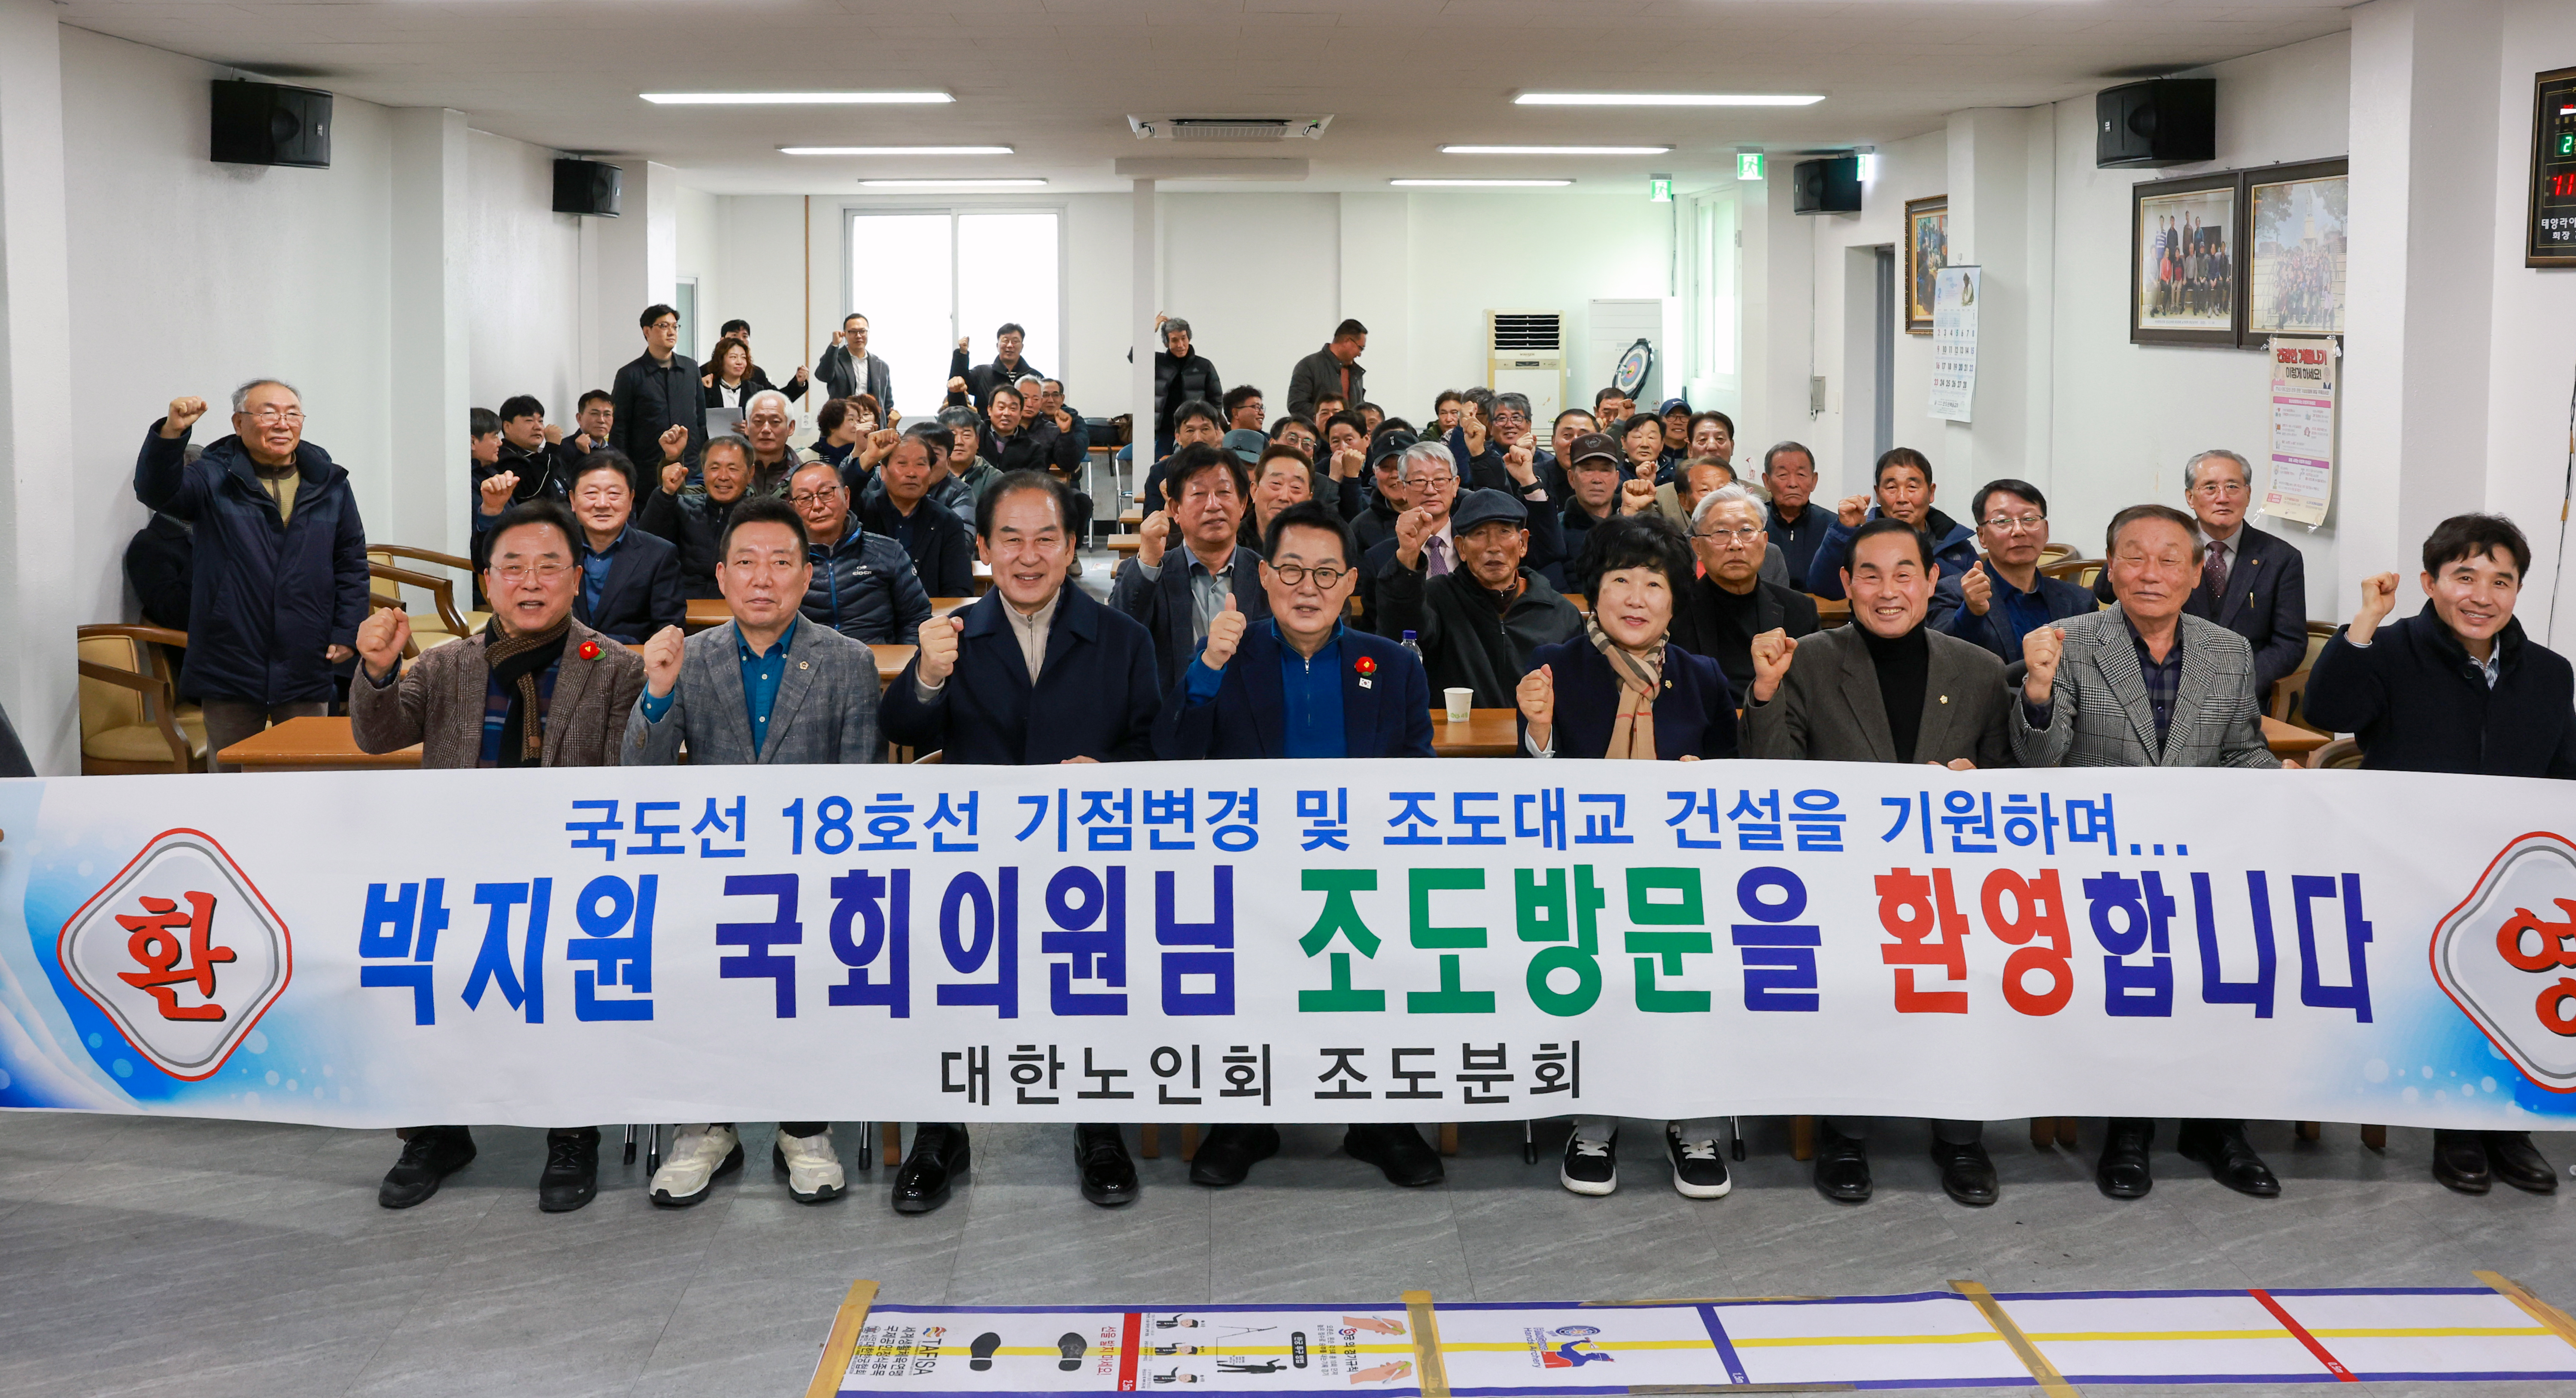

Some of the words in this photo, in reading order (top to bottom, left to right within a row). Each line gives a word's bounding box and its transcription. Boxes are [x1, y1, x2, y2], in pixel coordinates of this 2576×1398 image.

[2552, 231, 2570, 240] 회장
[1938, 288, 1941, 298] 2
[2277, 348, 2297, 363] 건강한
[2298, 349, 2327, 365] 겨울나기
[2286, 367, 2302, 379] 이렇게
[2303, 368, 2321, 380] 하세요!
[565, 796, 746, 861] 국도선
[782, 790, 978, 855] 18호선
[1015, 787, 1259, 852] 기점변경
[1297, 787, 1350, 851] 및
[1383, 787, 1634, 851] 조도대교
[1665, 788, 1846, 852] 건설을
[1881, 790, 2188, 856] 기원하며...
[115, 890, 237, 1022] 환
[358, 874, 658, 1026] 박지원
[716, 865, 1235, 1018] 국회의원님
[1299, 864, 1821, 1017] 조도방문을
[1874, 867, 2373, 1023] 환영합니다
[942, 1044, 1271, 1106] 대한노인회
[1315, 1040, 1580, 1104] 조도분회
[1101, 1326, 1116, 1338] 선을
[870, 1325, 899, 1377] 국제공인정식종목
[889, 1326, 916, 1377] 세계생활체육연맹
[913, 1338, 942, 1376] TAFISA
[1100, 1340, 1115, 1353] 밟지
[1295, 1346, 1304, 1354] 투구
[1523, 1327, 1535, 1345] Hands
[1529, 1346, 1541, 1368] Archery
[854, 1342, 875, 1375] 대한한궁협회
[1097, 1355, 1113, 1375] 마세요!
[1296, 1355, 1305, 1364] 방법
[1344, 1349, 1359, 1372] 경기규칙
